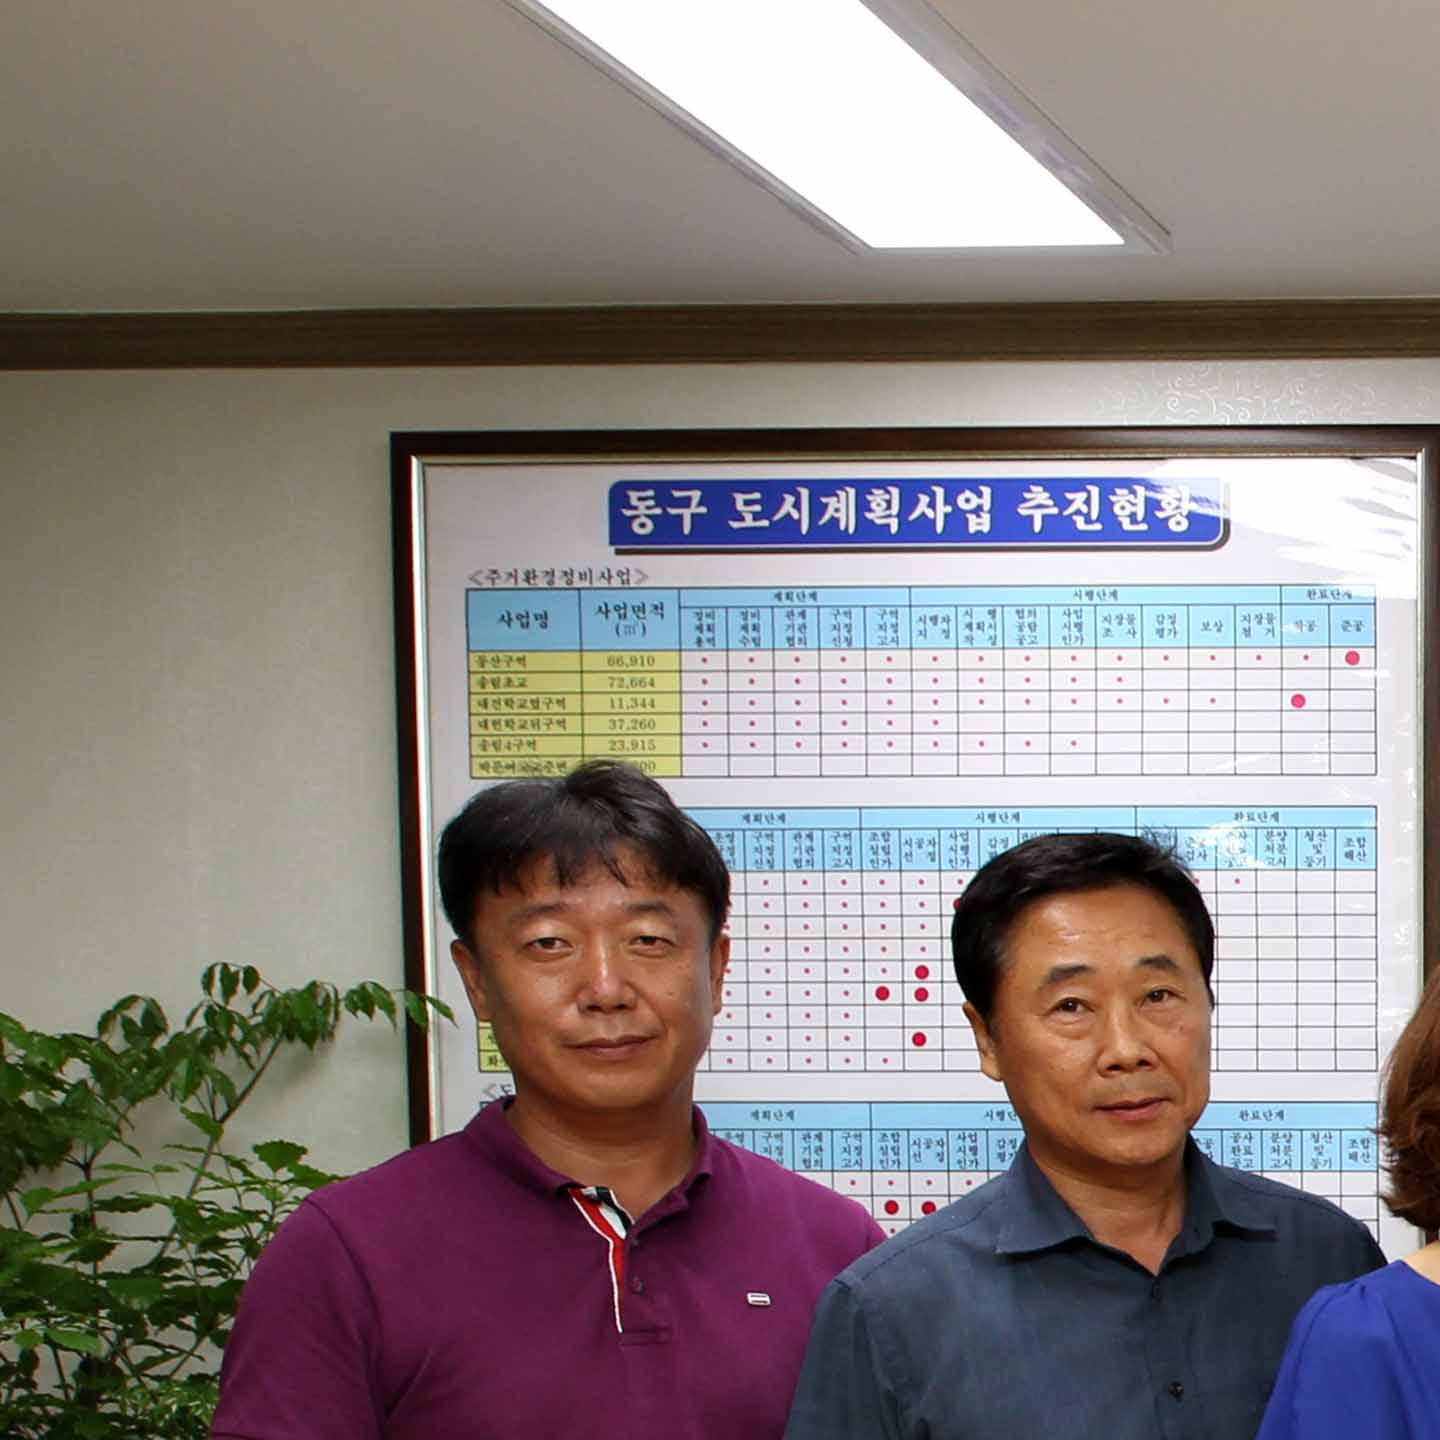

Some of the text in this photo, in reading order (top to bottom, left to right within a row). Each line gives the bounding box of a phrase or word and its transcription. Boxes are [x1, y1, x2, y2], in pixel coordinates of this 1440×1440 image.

[621, 485, 1192, 535] 동구 도시계획사업 추진현황
[1073, 589, 1118, 601] 시행단계
[595, 601, 665, 620] 사업면적
[498, 609, 549, 629] 사업명
[607, 656, 655, 668] 66,910
[608, 718, 656, 731] 37,260
[608, 740, 656, 752] 23,915
[984, 1110, 1016, 1121] 시행단
